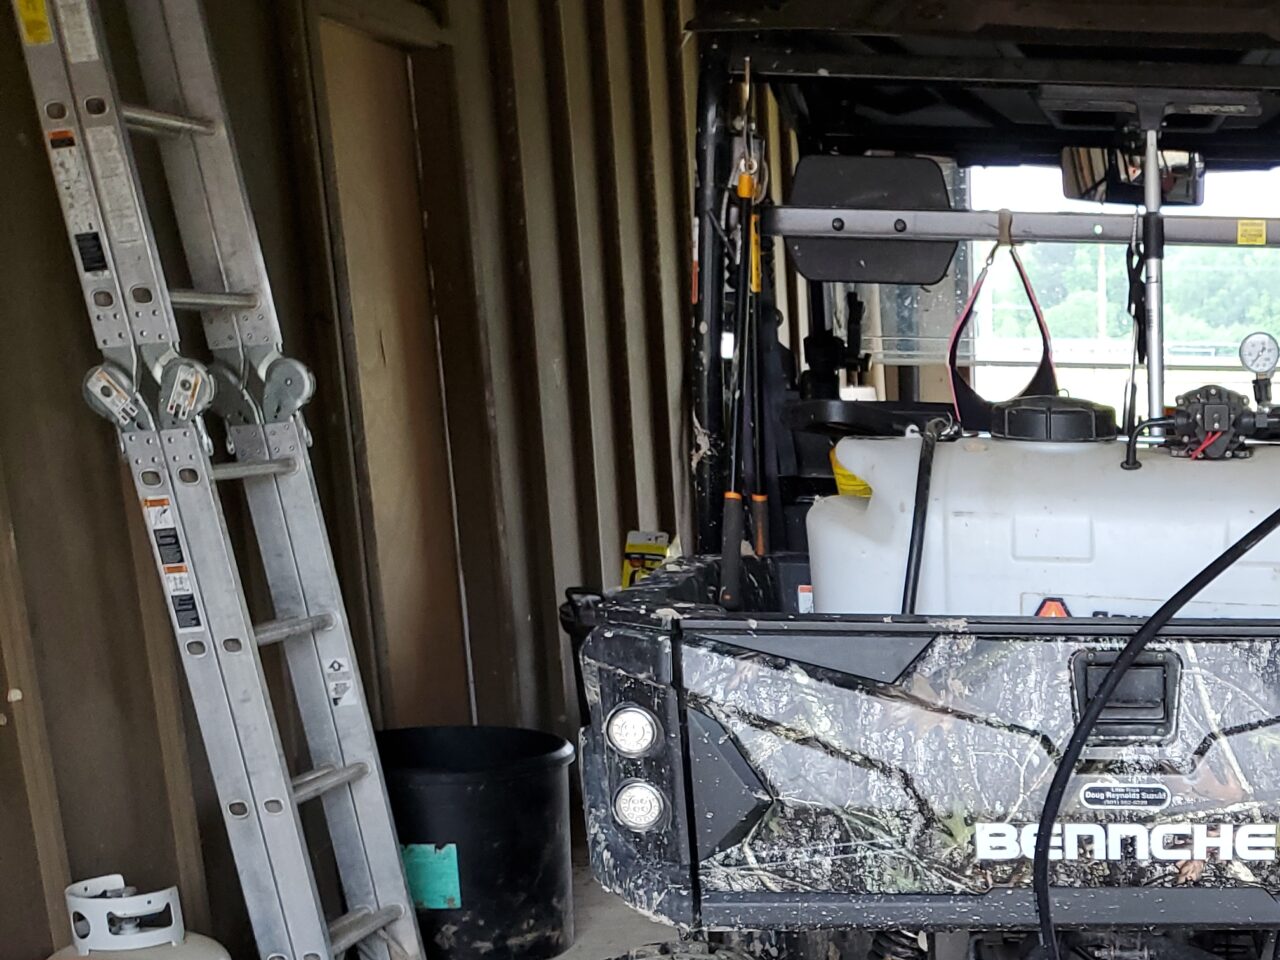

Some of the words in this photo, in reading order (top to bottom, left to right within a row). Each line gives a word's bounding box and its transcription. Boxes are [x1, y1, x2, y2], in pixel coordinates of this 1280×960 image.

[1085, 791, 1105, 800] Doug
[1105, 791, 1140, 800] Reynolds
[975, 823, 1277, 861] BENNCHE
